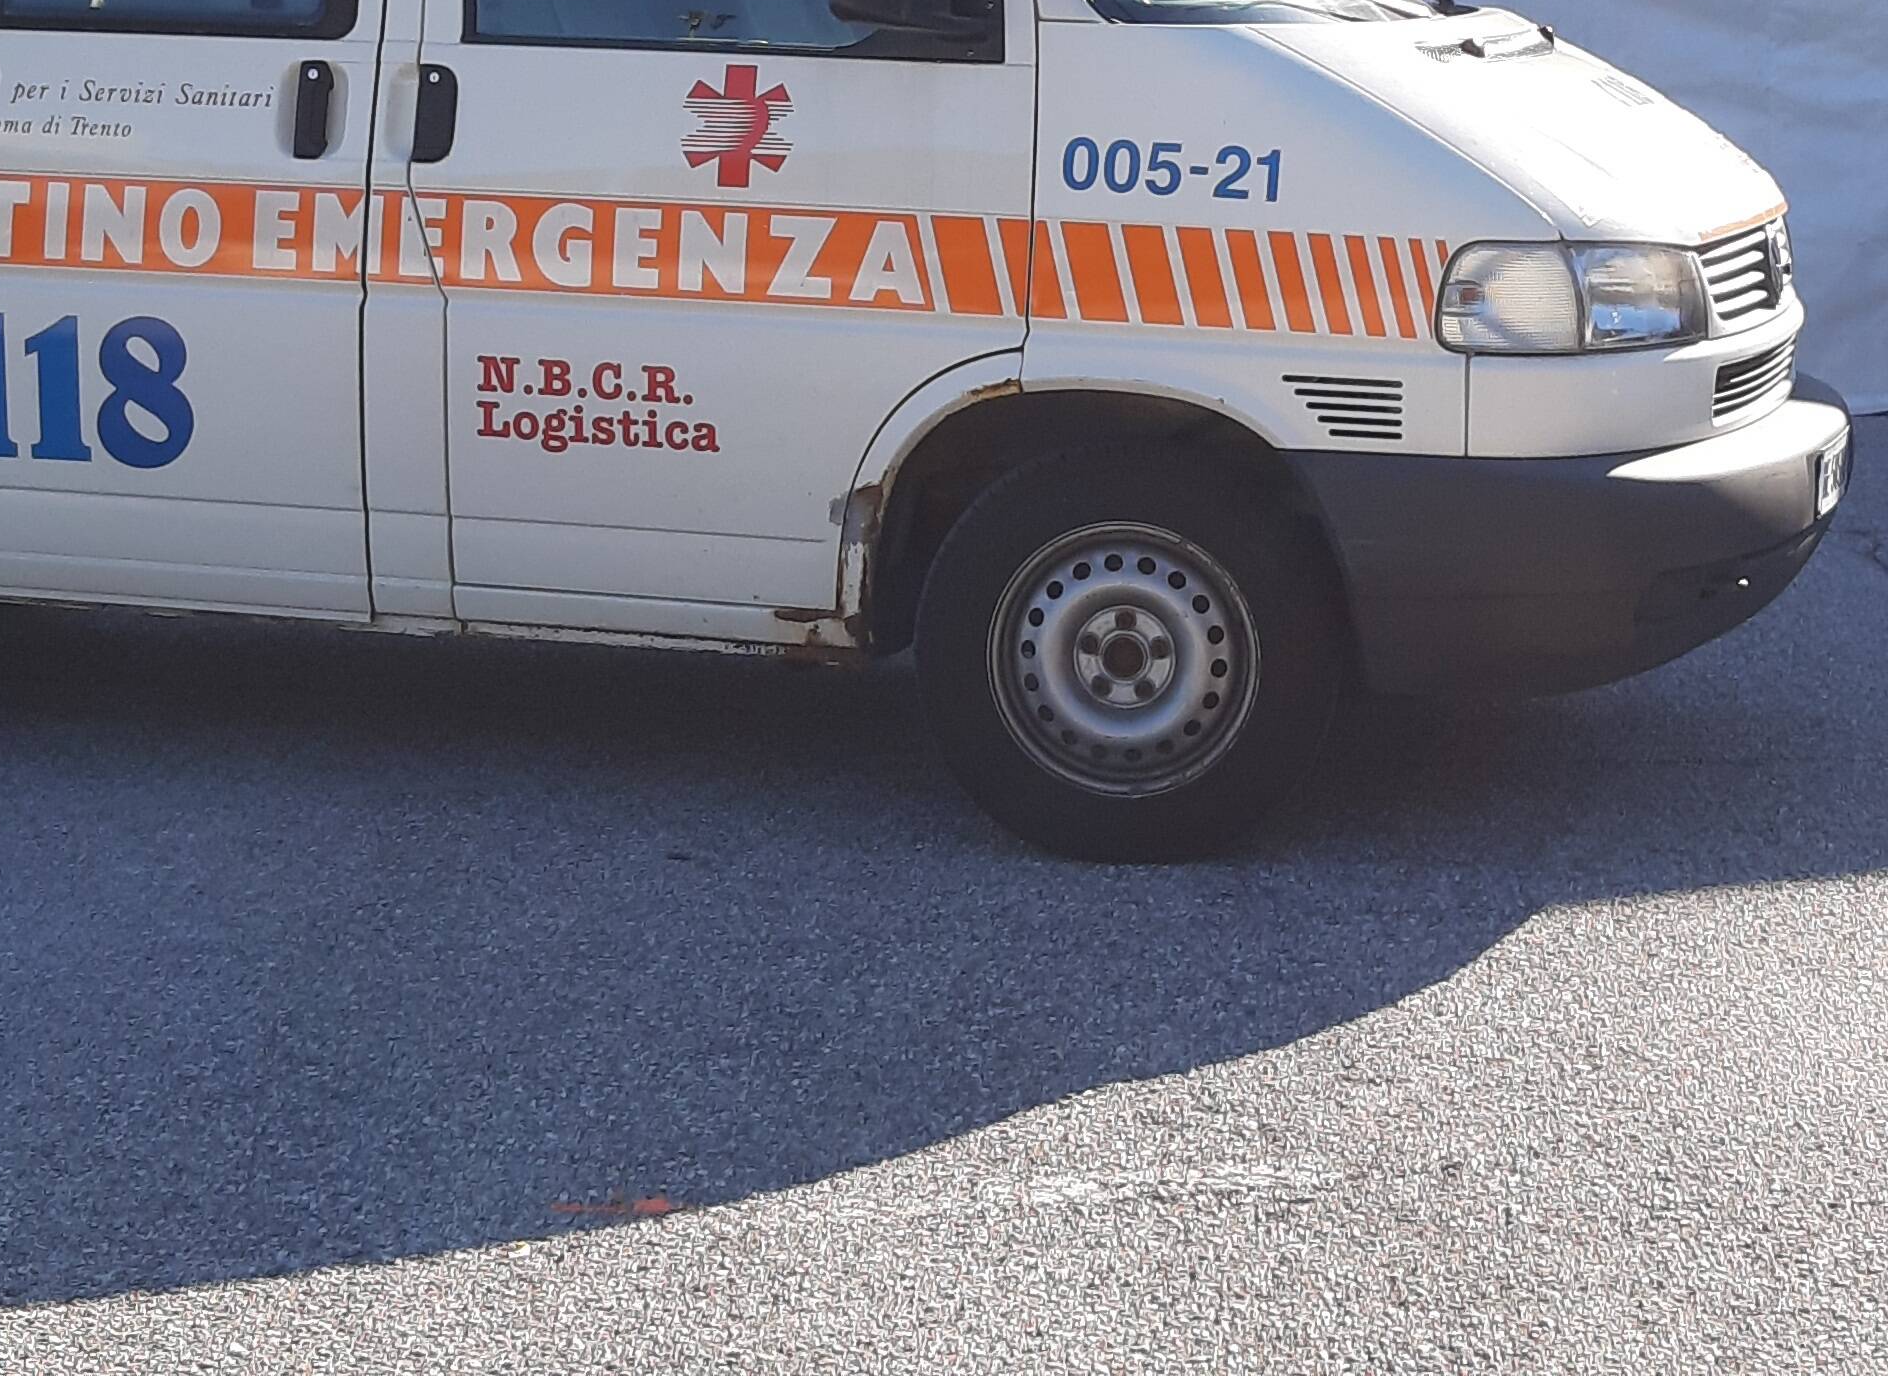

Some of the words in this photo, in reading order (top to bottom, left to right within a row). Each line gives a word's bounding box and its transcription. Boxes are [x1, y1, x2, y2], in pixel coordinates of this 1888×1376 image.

[10, 81, 50, 104] per
[60, 79, 71, 102] i
[78, 80, 166, 105] Servizi
[175, 82, 275, 108] Sanitari
[42, 115, 62, 136] di
[70, 116, 132, 138] Trento
[1062, 136, 1281, 203] 005-21
[252, 190, 926, 305] EMERGENZA
[476, 354, 694, 405] N.B.C.R.
[476, 400, 720, 453] Logistica
